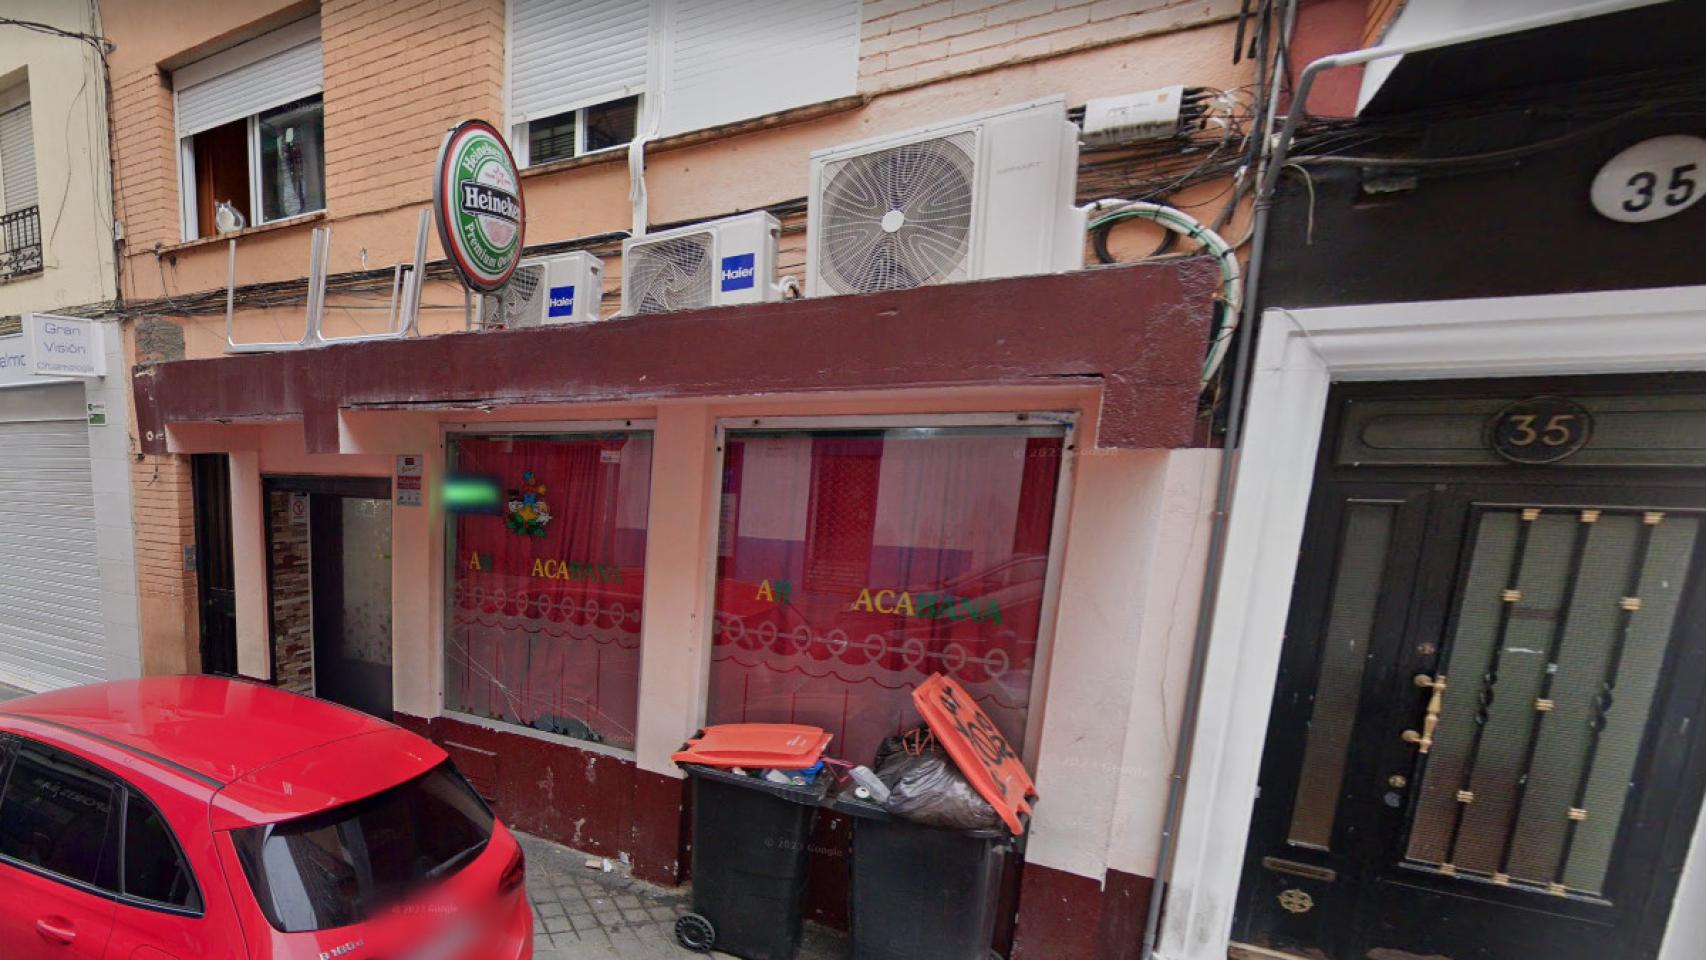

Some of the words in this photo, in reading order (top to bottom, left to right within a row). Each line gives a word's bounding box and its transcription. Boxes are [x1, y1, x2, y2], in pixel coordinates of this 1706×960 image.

[464, 185, 520, 219] Heineke
[1622, 163, 1698, 213] 35
[721, 267, 754, 281] Haier
[550, 297, 574, 307] Haier
[44, 322, 81, 336] Gran
[1508, 414, 1575, 446] 35
[853, 588, 1002, 625] ACABANA
